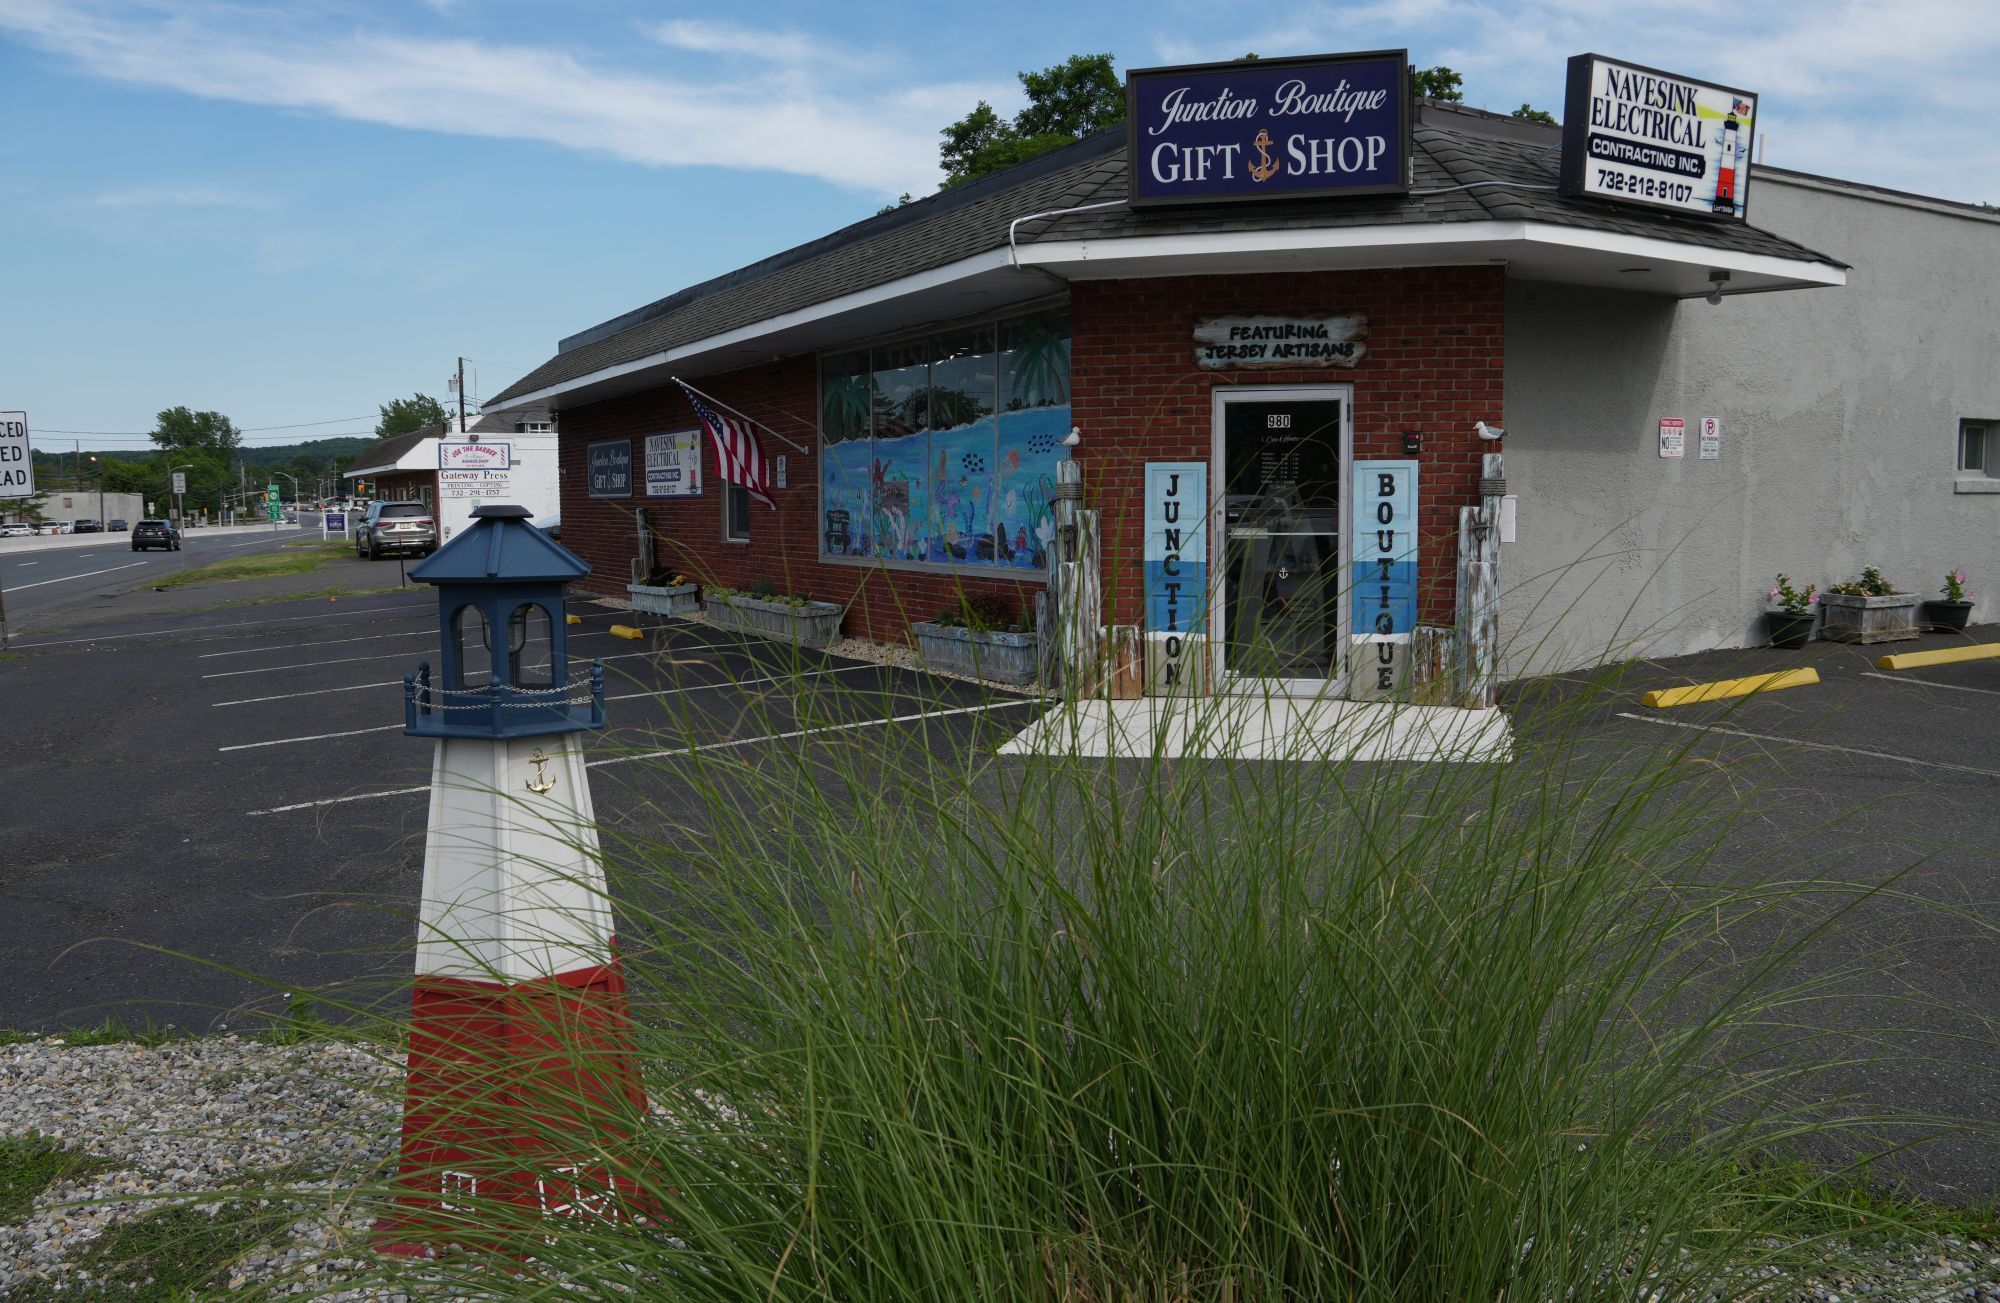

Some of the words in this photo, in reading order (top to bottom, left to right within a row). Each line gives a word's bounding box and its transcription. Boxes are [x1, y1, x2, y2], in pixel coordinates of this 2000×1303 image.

[1606, 68, 1698, 116] NAVESINK
[1148, 88, 1258, 136] Junction
[1269, 80, 1386, 122] Boutique
[1591, 96, 1706, 148] ELECTRICAL
[1151, 142, 1240, 184] GIFT
[1288, 134, 1386, 176] SHOP
[1592, 138, 1676, 168] CONTRACTING
[1679, 158, 1700, 174] INC.
[1598, 169, 1692, 202] 732-212-8107
[1230, 324, 1328, 340] FEATURING
[1206, 344, 1267, 359] JERSEY
[1272, 342, 1354, 358] ARTISANS
[1268, 415, 1290, 427] 980
[650, 435, 677, 452] NAVESINK
[1662, 437, 1669, 449] NO
[452, 448, 462, 458] JOE
[475, 446, 497, 457] BARBER
[647, 451, 680, 467] ELECTRICAL
[0, 470, 26, 486] AD
[441, 470, 479, 480] Gateway
[483, 470, 508, 480] Press
[595, 473, 606, 488] GIFT
[612, 472, 626, 488] SHOP
[1163, 474, 1182, 686] JUNCTION
[1375, 474, 1395, 690] BOUTIQUE
